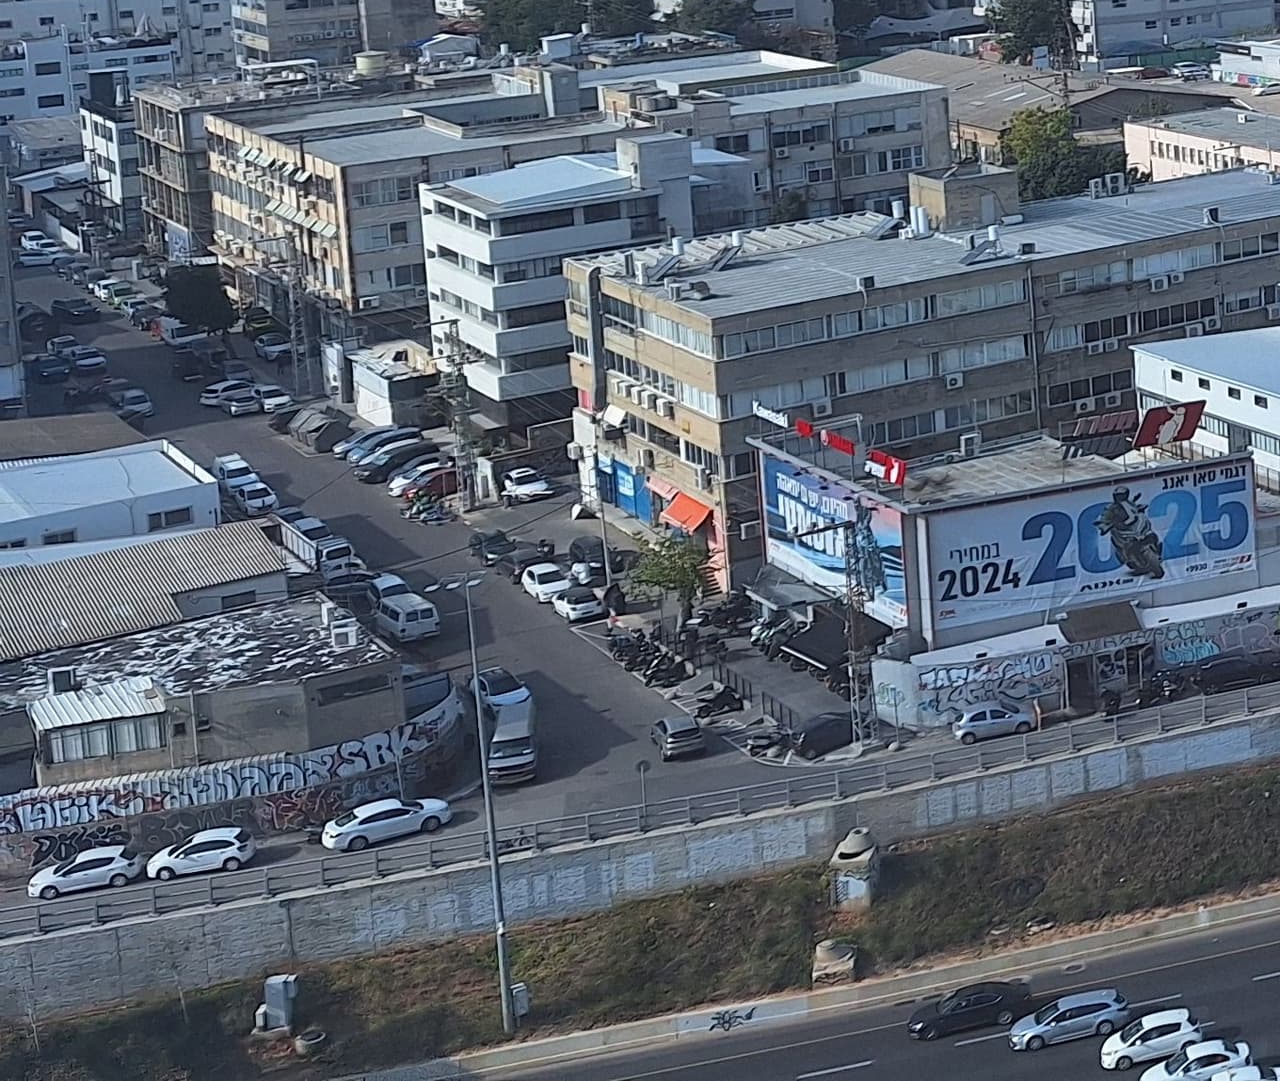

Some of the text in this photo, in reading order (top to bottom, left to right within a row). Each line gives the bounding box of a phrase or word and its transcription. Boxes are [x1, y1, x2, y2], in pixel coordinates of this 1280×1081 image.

[1161, 464, 1247, 491] דגמי סאן יאנג
[1021, 478, 1249, 587] 2025
[949, 542, 1000, 564] במחירי
[937, 558, 1021, 602] 2024
